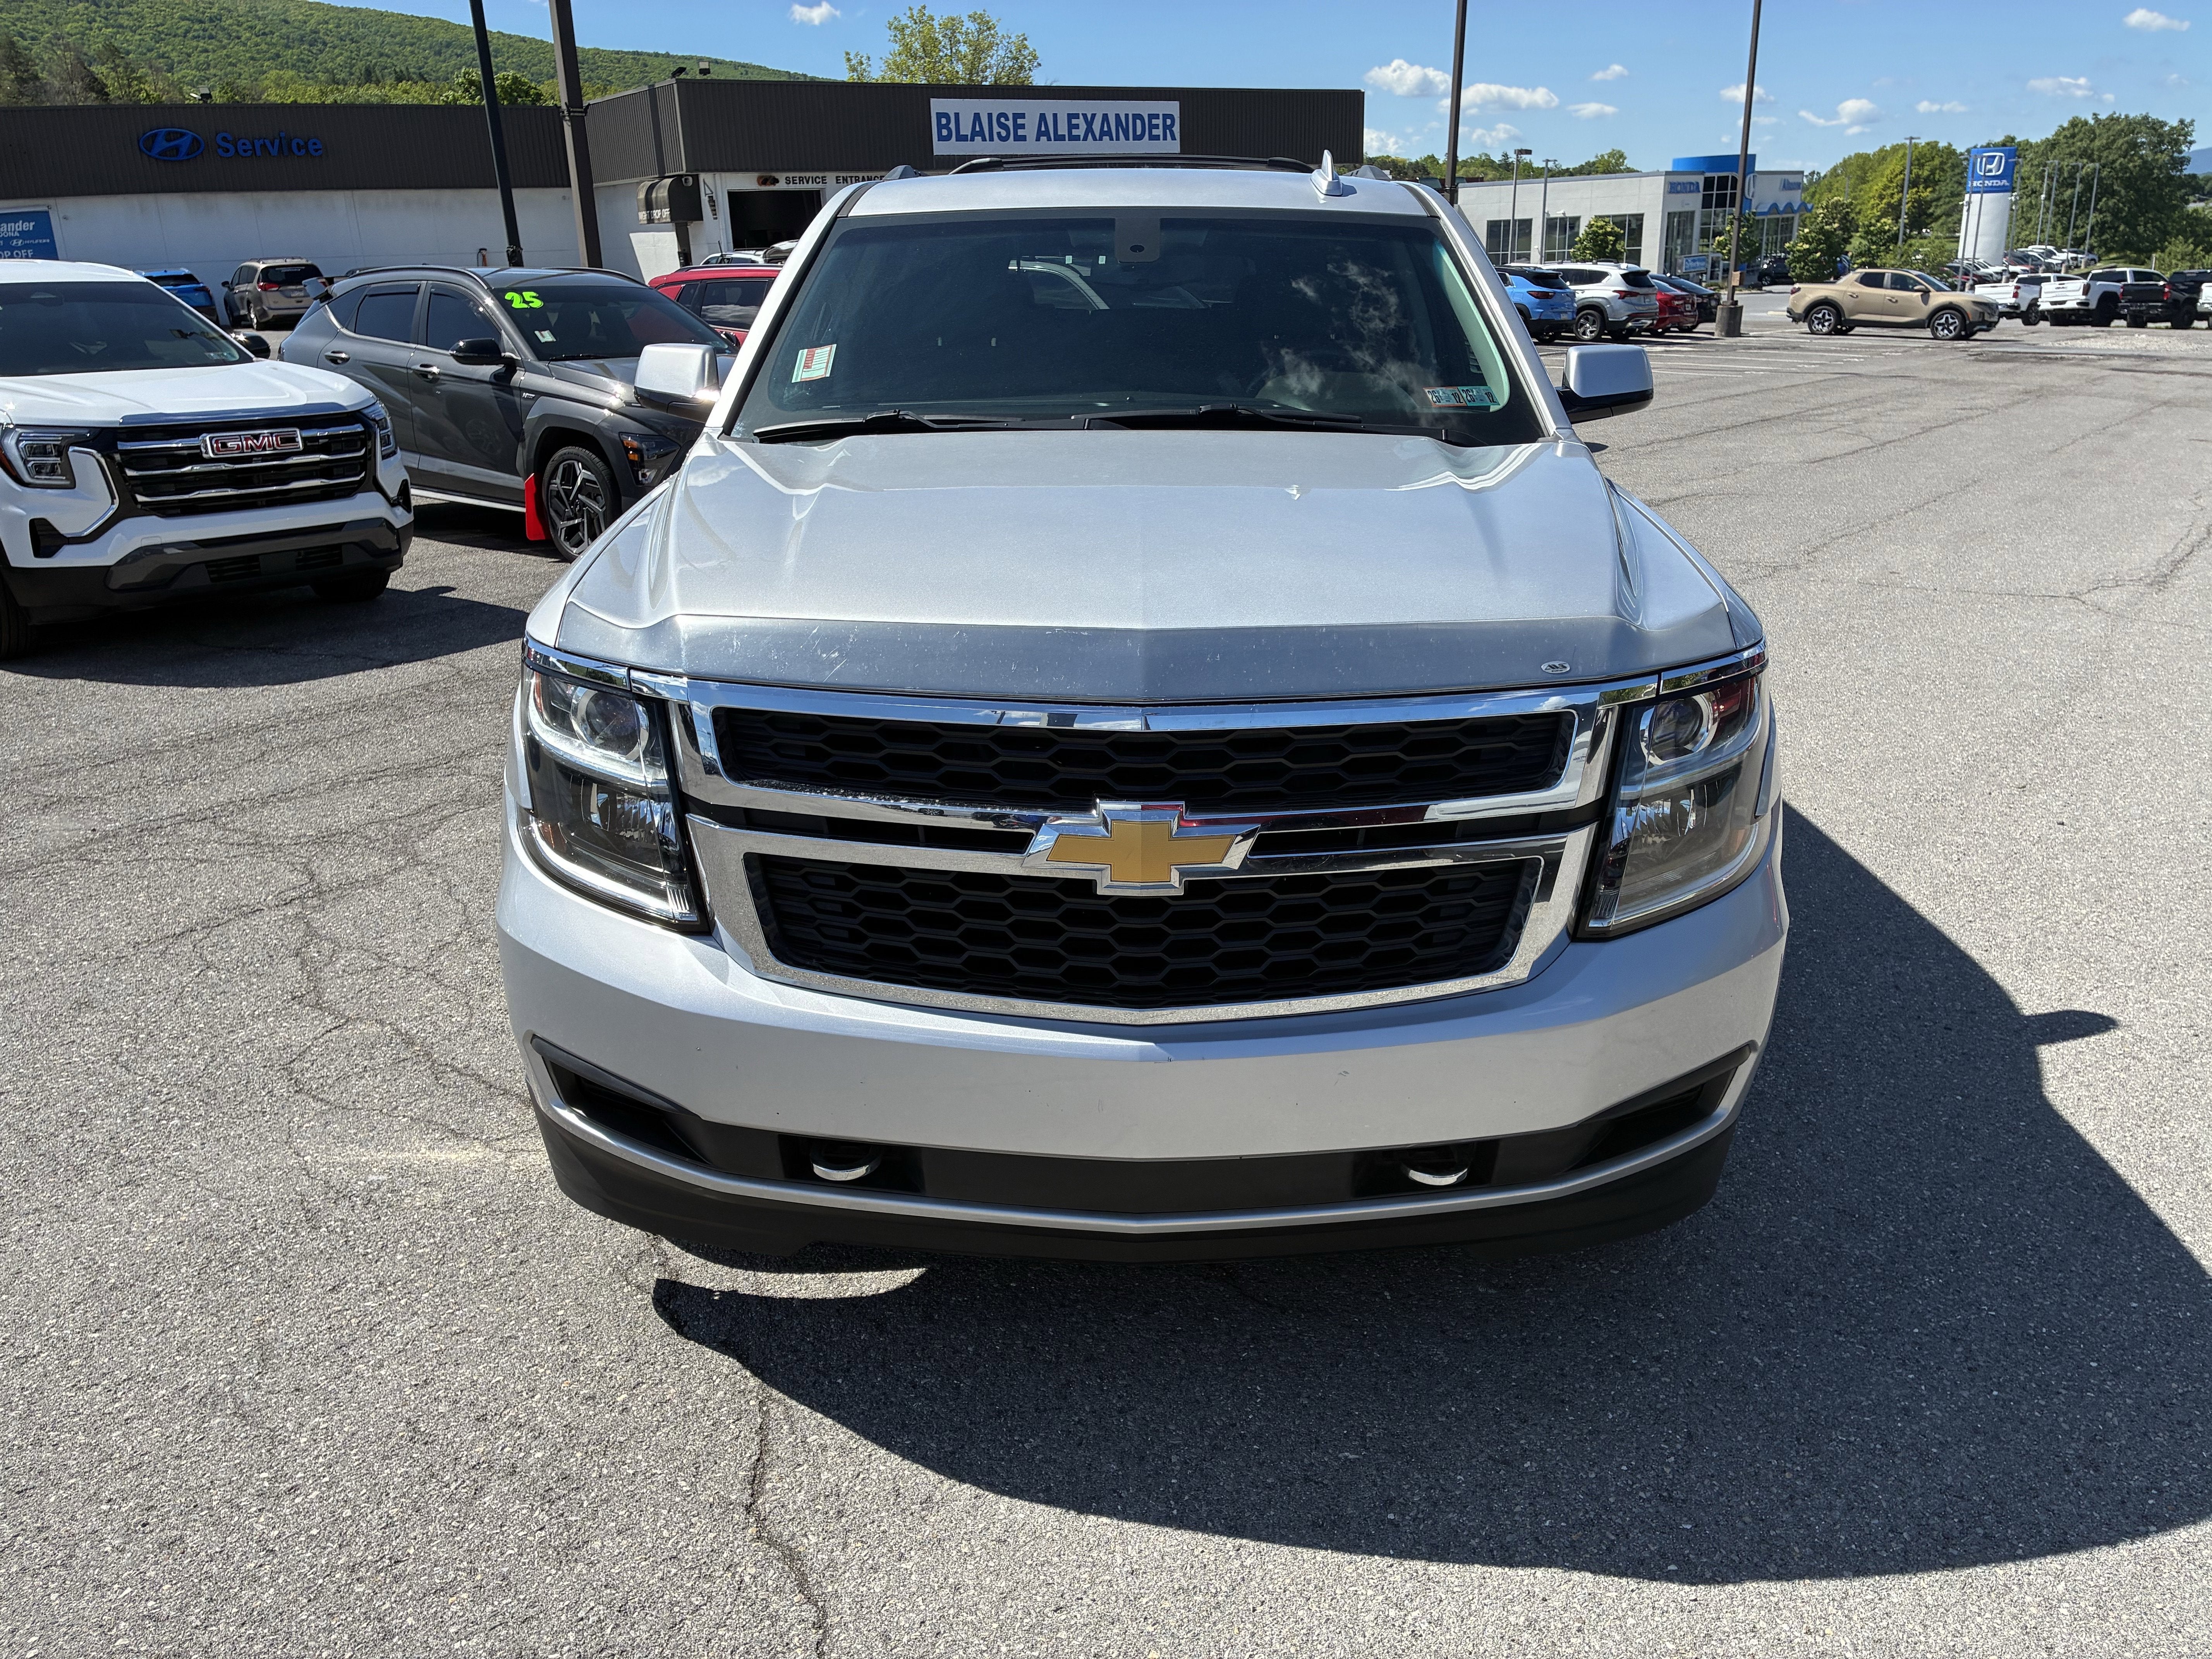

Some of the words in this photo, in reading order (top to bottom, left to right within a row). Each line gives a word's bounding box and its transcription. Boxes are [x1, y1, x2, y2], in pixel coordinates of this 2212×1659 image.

[935, 112, 1027, 143] BLAISE
[1035, 113, 1177, 142] ALEXANDER
[216, 131, 322, 158] Service
[785, 176, 828, 185] SERVICE
[13, 249, 33, 258] OFF
[505, 292, 544, 309] 25
[1427, 390, 1441, 404] 26
[1451, 392, 1463, 404] 12
[1462, 389, 1476, 403] 26
[1484, 392, 1497, 403] 12
[212, 431, 299, 454] GMC
